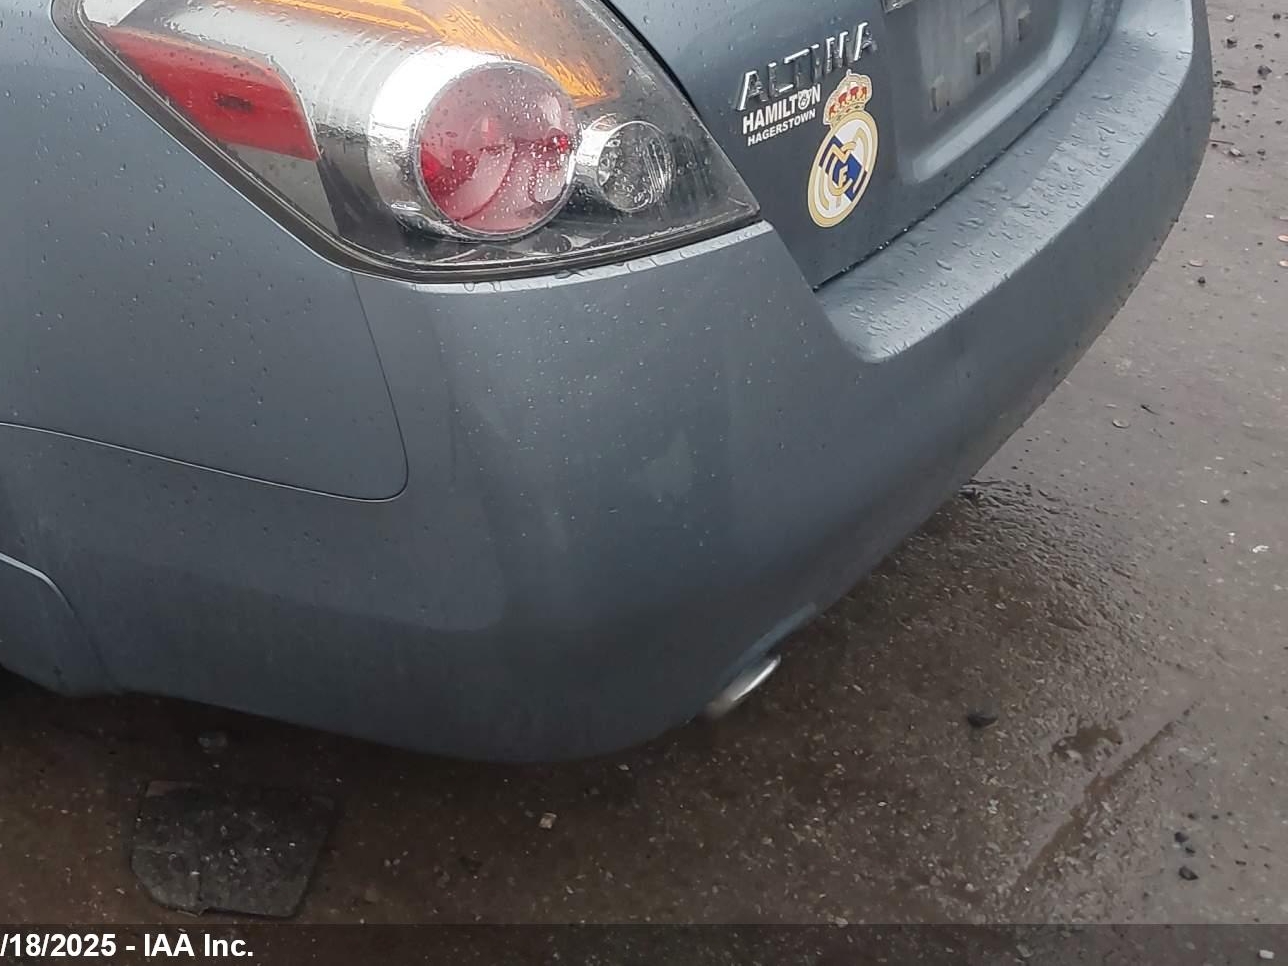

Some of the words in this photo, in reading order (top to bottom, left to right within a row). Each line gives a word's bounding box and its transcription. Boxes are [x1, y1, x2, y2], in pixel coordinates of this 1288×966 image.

[736, 22, 877, 110] ALTIMA
[742, 84, 821, 134] HAMILTON
[747, 108, 816, 146] HAGERSTOWN
